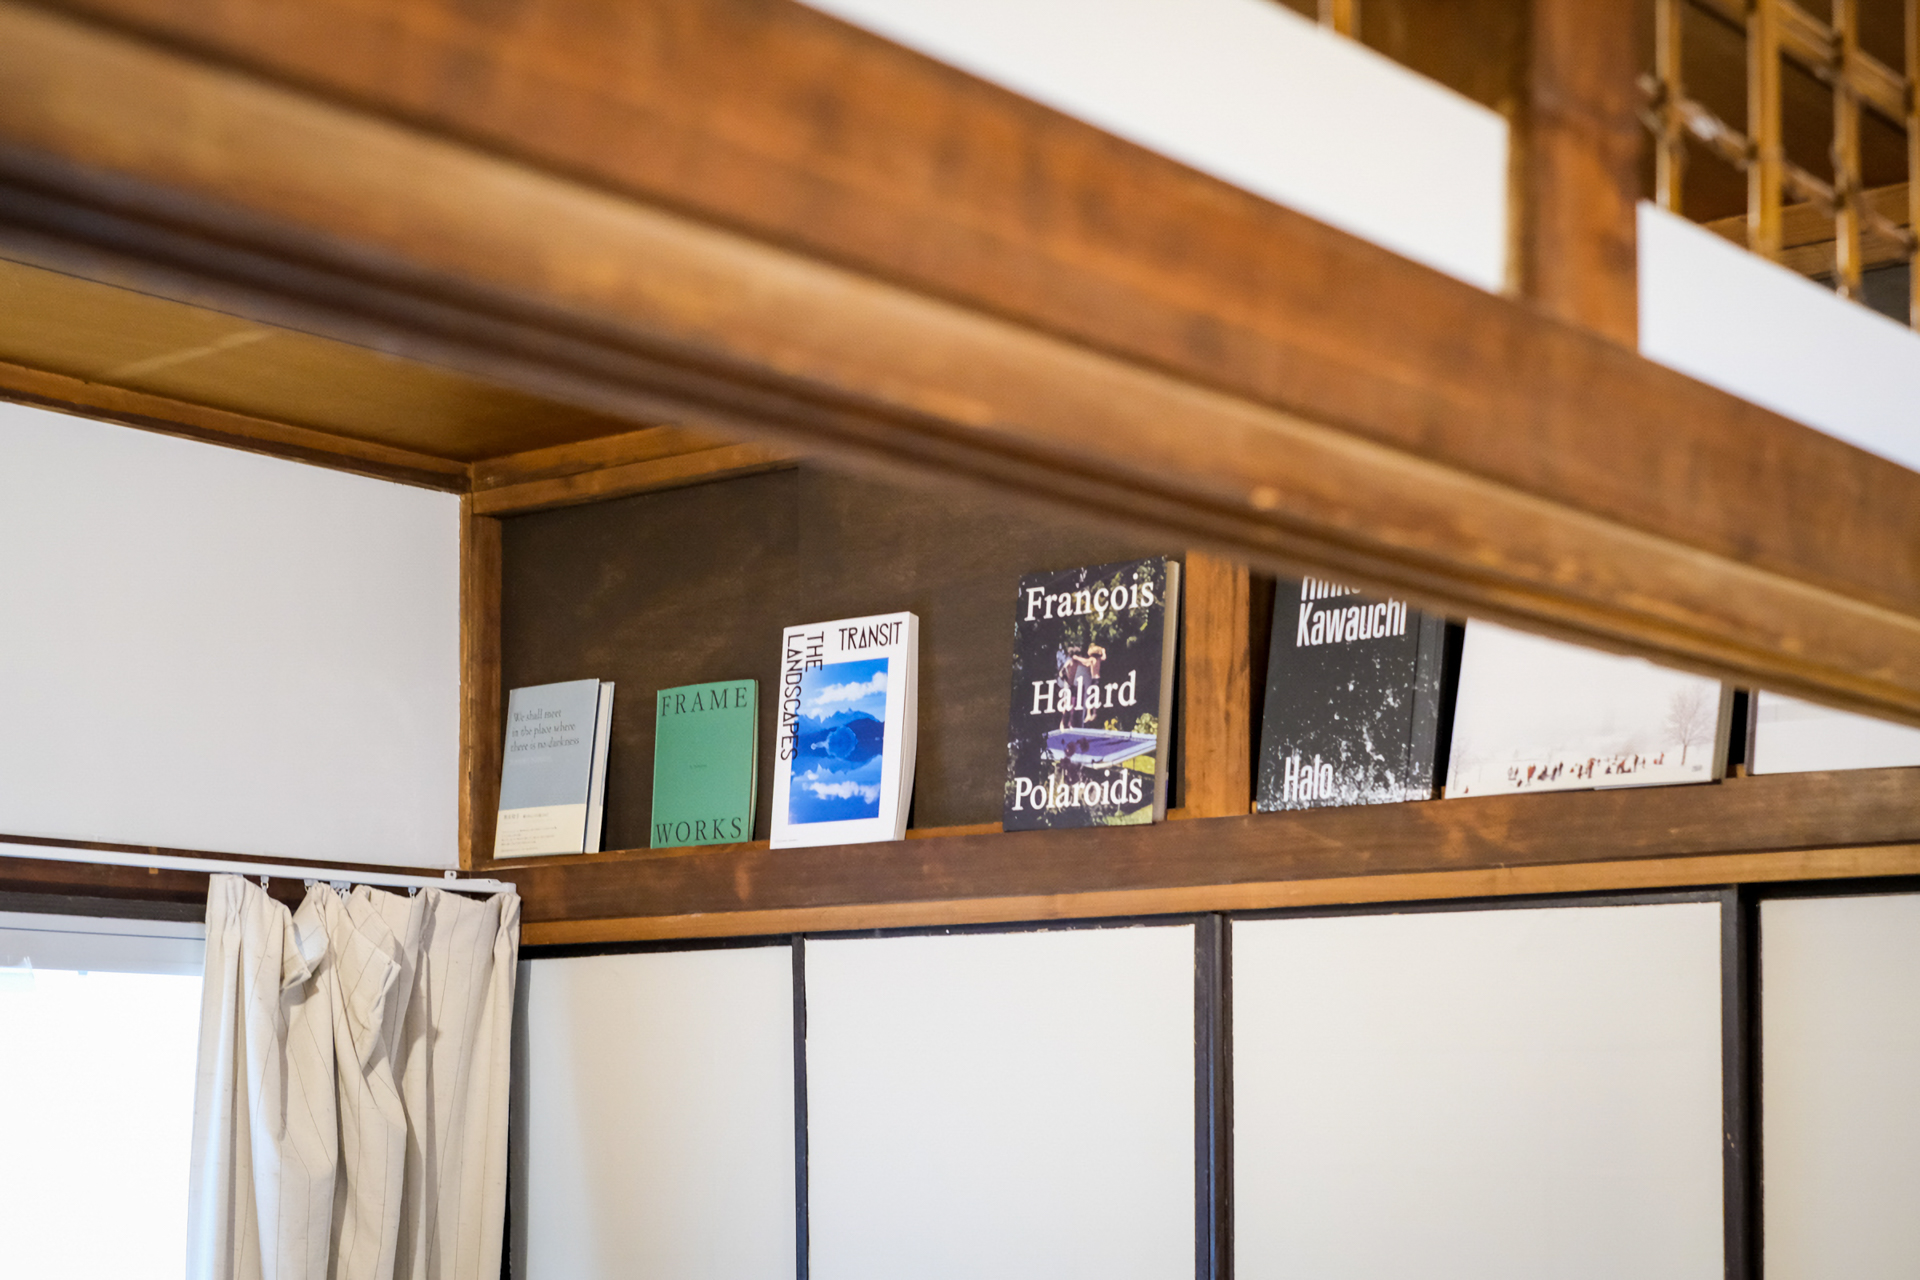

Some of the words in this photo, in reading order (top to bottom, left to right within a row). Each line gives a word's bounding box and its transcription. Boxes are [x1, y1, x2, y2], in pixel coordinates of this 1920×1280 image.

[1024, 573, 1154, 621] François
[839, 621, 902, 651] TRANSIT
[1297, 598, 1407, 647] Kawauchi
[805, 631, 824, 672] THE
[661, 687, 748, 716] FRAME
[780, 633, 805, 761] LANDSCAPES
[1030, 670, 1137, 715] Halard
[1012, 768, 1143, 811] Polaroids
[1283, 754, 1334, 802] Halo
[656, 817, 743, 844] WORKS
